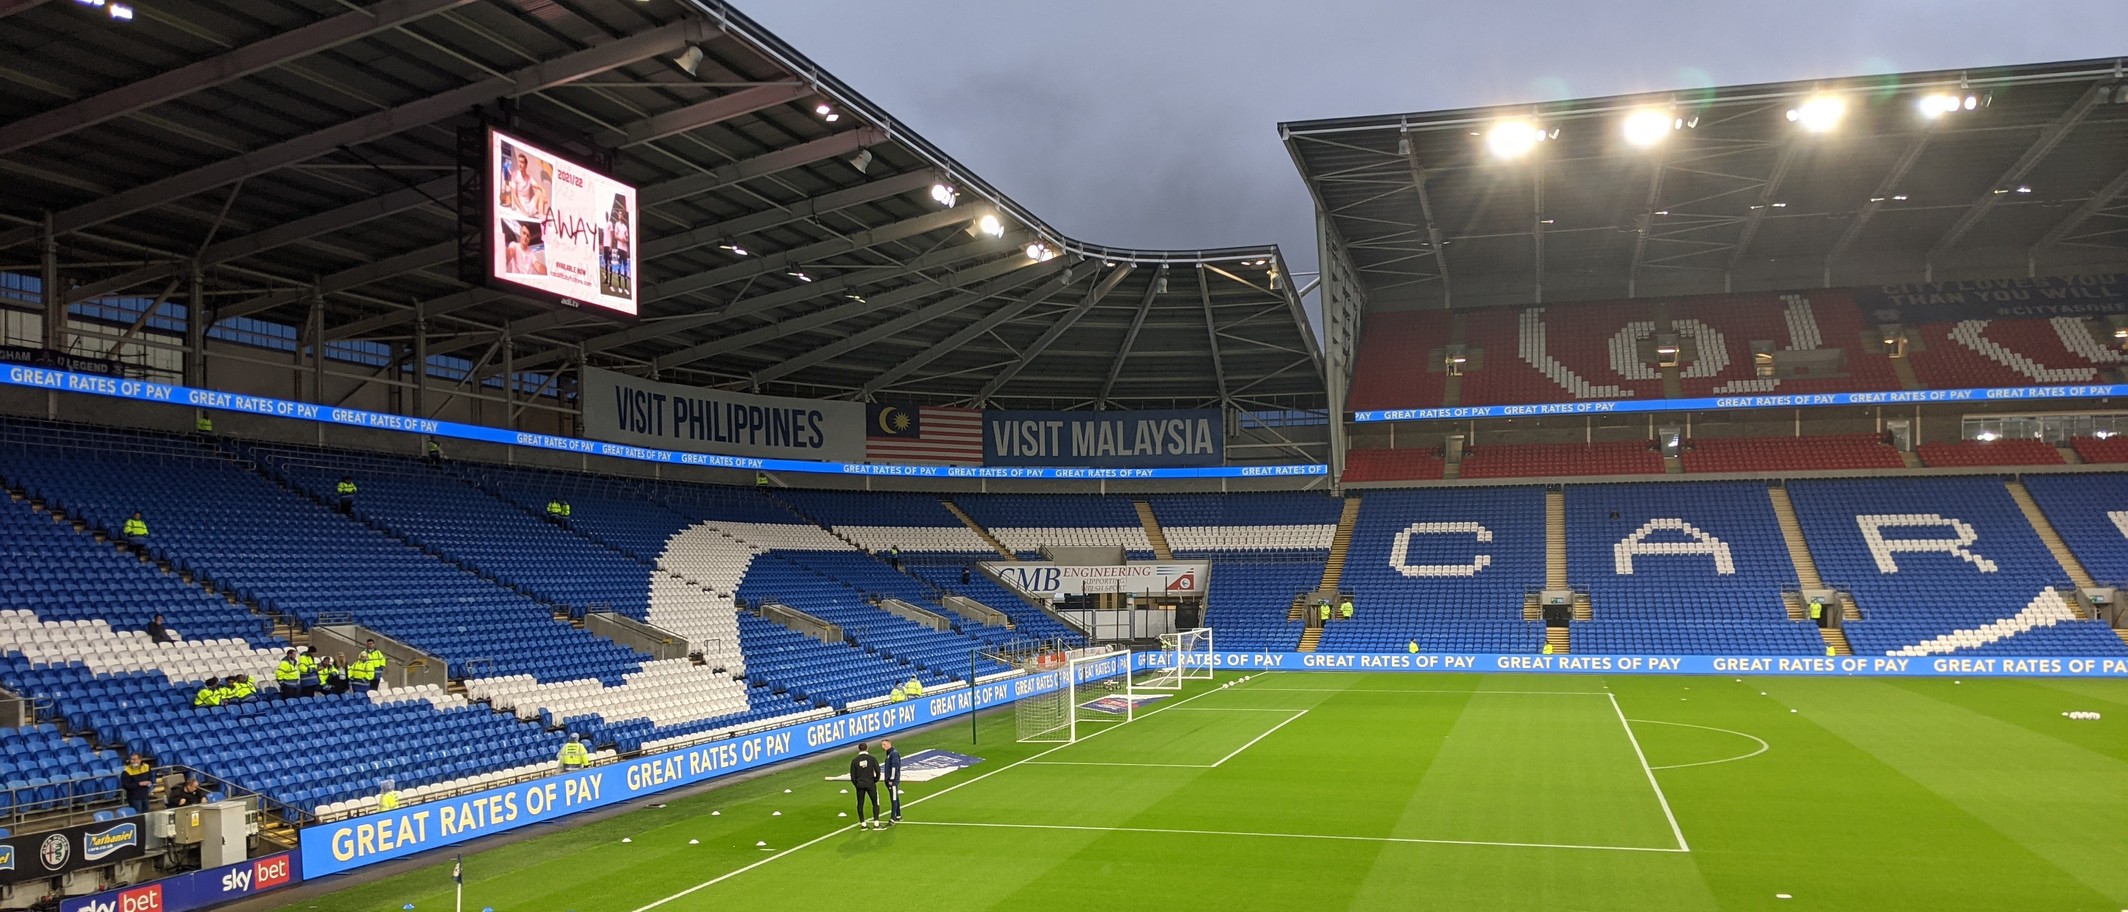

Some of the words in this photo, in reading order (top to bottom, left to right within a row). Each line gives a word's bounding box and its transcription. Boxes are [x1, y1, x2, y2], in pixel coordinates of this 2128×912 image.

[557, 169, 584, 189] 2021/22
[540, 206, 598, 252] AWAY
[1888, 292, 1966, 305] THAN
[1973, 289, 2032, 302] YOU
[2040, 286, 2123, 299] WILL
[66, 358, 109, 373] LEGEND
[10, 367, 64, 387] GREAT
[69, 374, 117, 394] RATES
[121, 382, 142, 396] OF
[146, 386, 172, 400] PAY
[1849, 392, 1886, 403] GREAT
[1890, 391, 1926, 401] RATES
[1930, 390, 1946, 400] OF
[1950, 390, 1972, 399] PAY
[1986, 388, 2026, 399] GREAT
[2028, 387, 2065, 398] RATES
[2069, 386, 2086, 396] OF
[2090, 386, 2113, 396] PAY
[189, 390, 232, 408] GREAT
[235, 396, 274, 413] RATES
[277, 402, 294, 414] OF
[297, 405, 319, 418] PAY
[1504, 405, 1537, 416] GREAT
[1539, 404, 1574, 414] RATES
[1577, 402, 1592, 412] OF
[1595, 402, 1616, 411] PAY
[1717, 398, 1753, 408] GREAT
[1756, 397, 1791, 406] RATES
[1794, 395, 1811, 405] OF
[1814, 394, 1836, 404] PAY
[332, 409, 367, 425] GREAT
[370, 414, 402, 429] RATES
[404, 418, 418, 431] OF
[420, 420, 439, 433] PAY
[615, 384, 667, 436] VISIT
[673, 396, 825, 449] PHILIPPINES
[1384, 409, 1417, 420] GREAT
[1419, 408, 1451, 418] RATES
[1454, 407, 1469, 417] OF
[1471, 407, 1491, 417] PAY
[516, 433, 542, 446] GREAT
[543, 436, 567, 449] RATES
[569, 439, 579, 450] OF
[581, 441, 595, 452] PAY
[992, 420, 1064, 457] VISIT
[1071, 418, 1214, 457] MALAYSIA
[602, 444, 624, 456] GREAT
[625, 447, 645, 459] RATES
[646, 450, 656, 460] OF
[657, 452, 672, 461] PAY
[681, 453, 708, 465] GREAT
[709, 455, 734, 467] RATES
[735, 457, 747, 468] OF
[748, 459, 763, 468] PAY
[843, 464, 873, 474] GREAT
[873, 465, 902, 475] RATES
[904, 466, 917, 475] OF
[920, 466, 937, 476] PAY
[948, 468, 977, 477] GREAT
[979, 468, 1008, 477] RATES
[1010, 468, 1023, 477] OF
[1026, 468, 1044, 478] PAY
[1055, 468, 1085, 478] GREAT
[1087, 469, 1117, 478] RATES
[1119, 469, 1133, 478] OF
[1136, 469, 1153, 478] PAY
[1242, 466, 1272, 476] GREAT
[1275, 465, 1305, 475] RATES
[1308, 464, 1322, 474] OF
[1063, 567, 1152, 578] ENGINEERING
[1180, 654, 1222, 666] RATES
[1227, 654, 1249, 666] OF
[1254, 654, 1284, 666] PAY
[1303, 655, 1358, 667] GREAT
[1361, 655, 1410, 668] RATES
[1416, 655, 1439, 668] OF
[1445, 656, 1476, 668] PAY
[1497, 656, 1553, 670] GREAT
[1558, 656, 1612, 670] RATES
[1618, 656, 1642, 670] OF
[1649, 657, 1681, 670] PAY
[1713, 657, 1770, 671] GREAT
[1779, 658, 1835, 672] RATES
[1841, 658, 1867, 672] OF
[1876, 659, 1909, 672] PAY
[1933, 659, 1996, 673] GREAT
[2002, 659, 2062, 673] RATES
[2068, 659, 2095, 673] OF
[1014, 680, 1035, 696] GREAT
[1036, 676, 1053, 691] RATES
[930, 694, 956, 717] GREAT
[983, 686, 993, 703] OF
[995, 683, 1008, 700] PAY
[807, 718, 845, 747] GREAT
[849, 711, 880, 737] RATES
[882, 708, 896, 728] OF
[899, 704, 915, 725] PAY
[626, 754, 684, 791] GREAT
[689, 743, 738, 776] RATES
[742, 737, 762, 763] OF
[766, 731, 792, 757] PAY
[331, 809, 430, 862] GREAT
[440, 790, 518, 837] RATES
[525, 782, 557, 816] OF
[564, 773, 603, 808] PAY
[222, 867, 253, 892] sky
[257, 859, 286, 882] bet
[123, 890, 159, 912] bet
